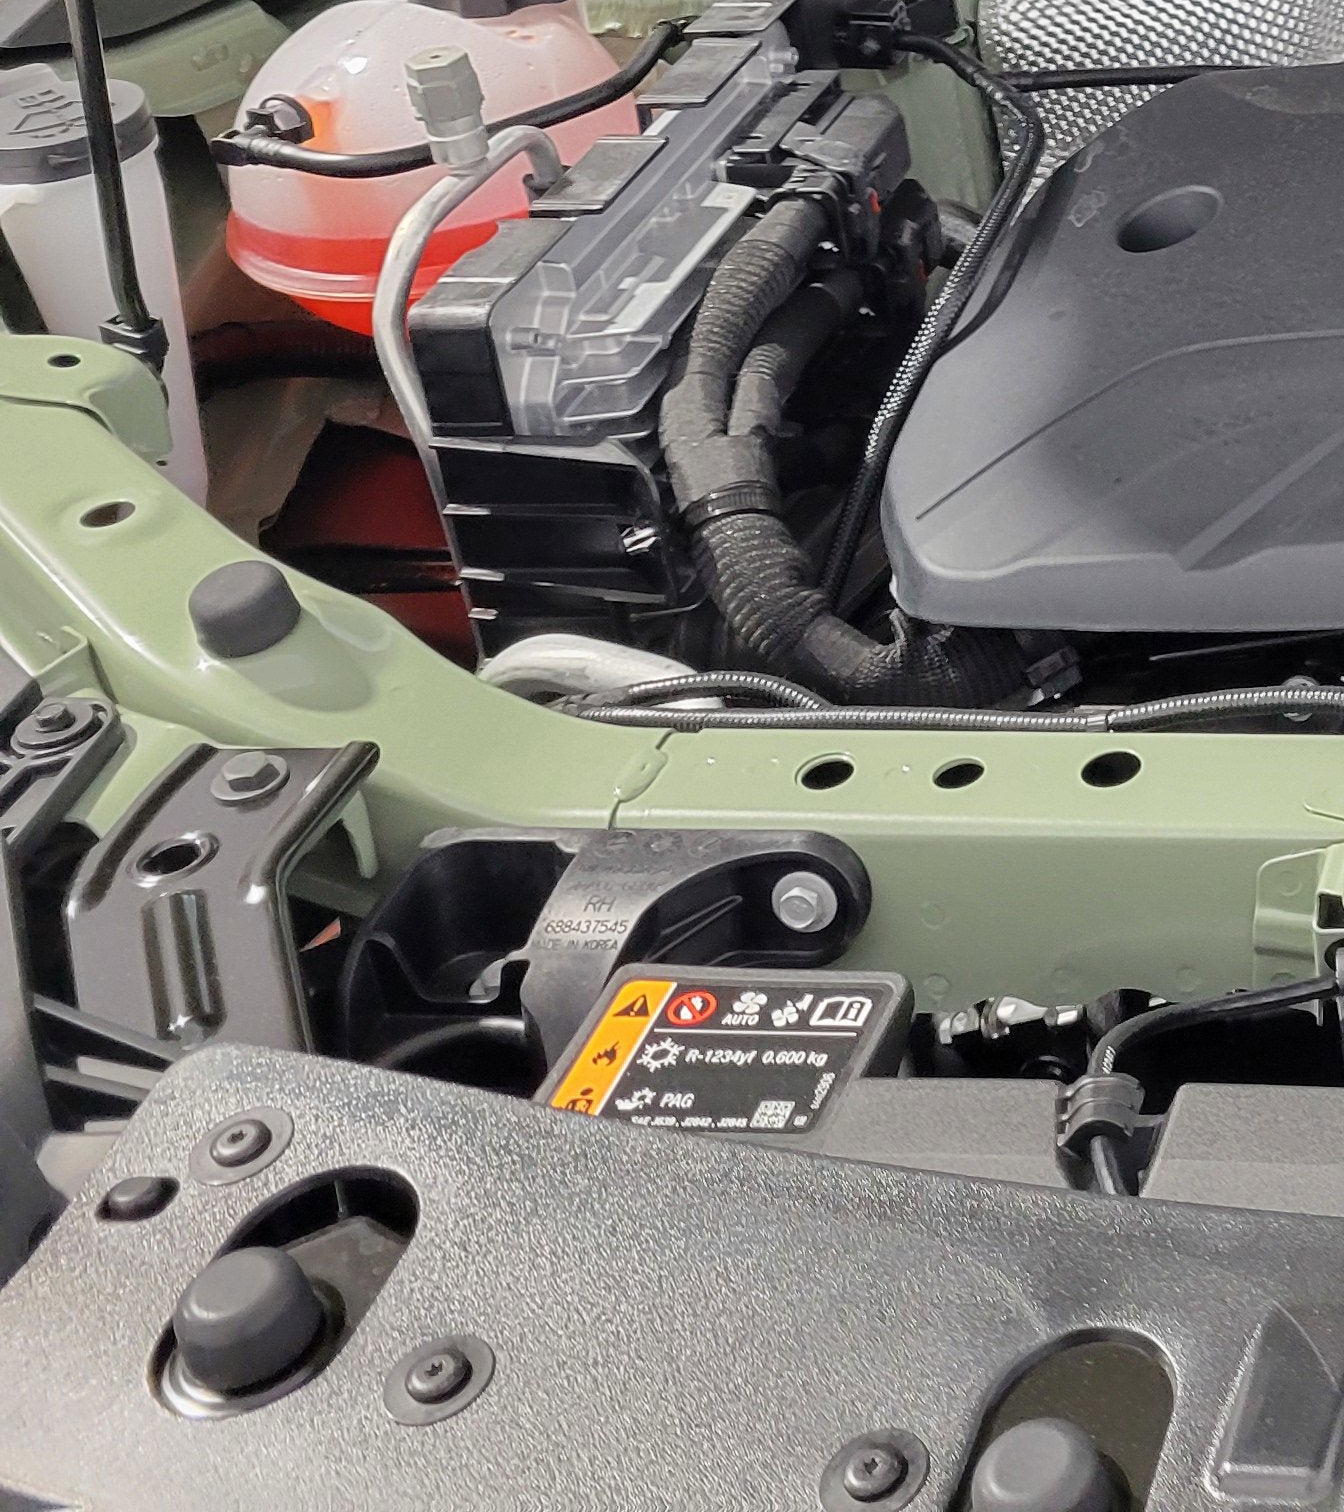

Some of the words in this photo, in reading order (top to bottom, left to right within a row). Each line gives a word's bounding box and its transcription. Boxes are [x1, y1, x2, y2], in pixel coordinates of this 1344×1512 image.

[583, 895, 617, 913] RH
[567, 939, 579, 950] IN
[582, 939, 618, 951] KOREA
[721, 1013, 760, 1026] AUTO
[685, 1049, 758, 1066] R-1234yf
[762, 1050, 807, 1065] 0.600
[807, 1051, 828, 1067] kg
[660, 1093, 695, 1108] PAG
